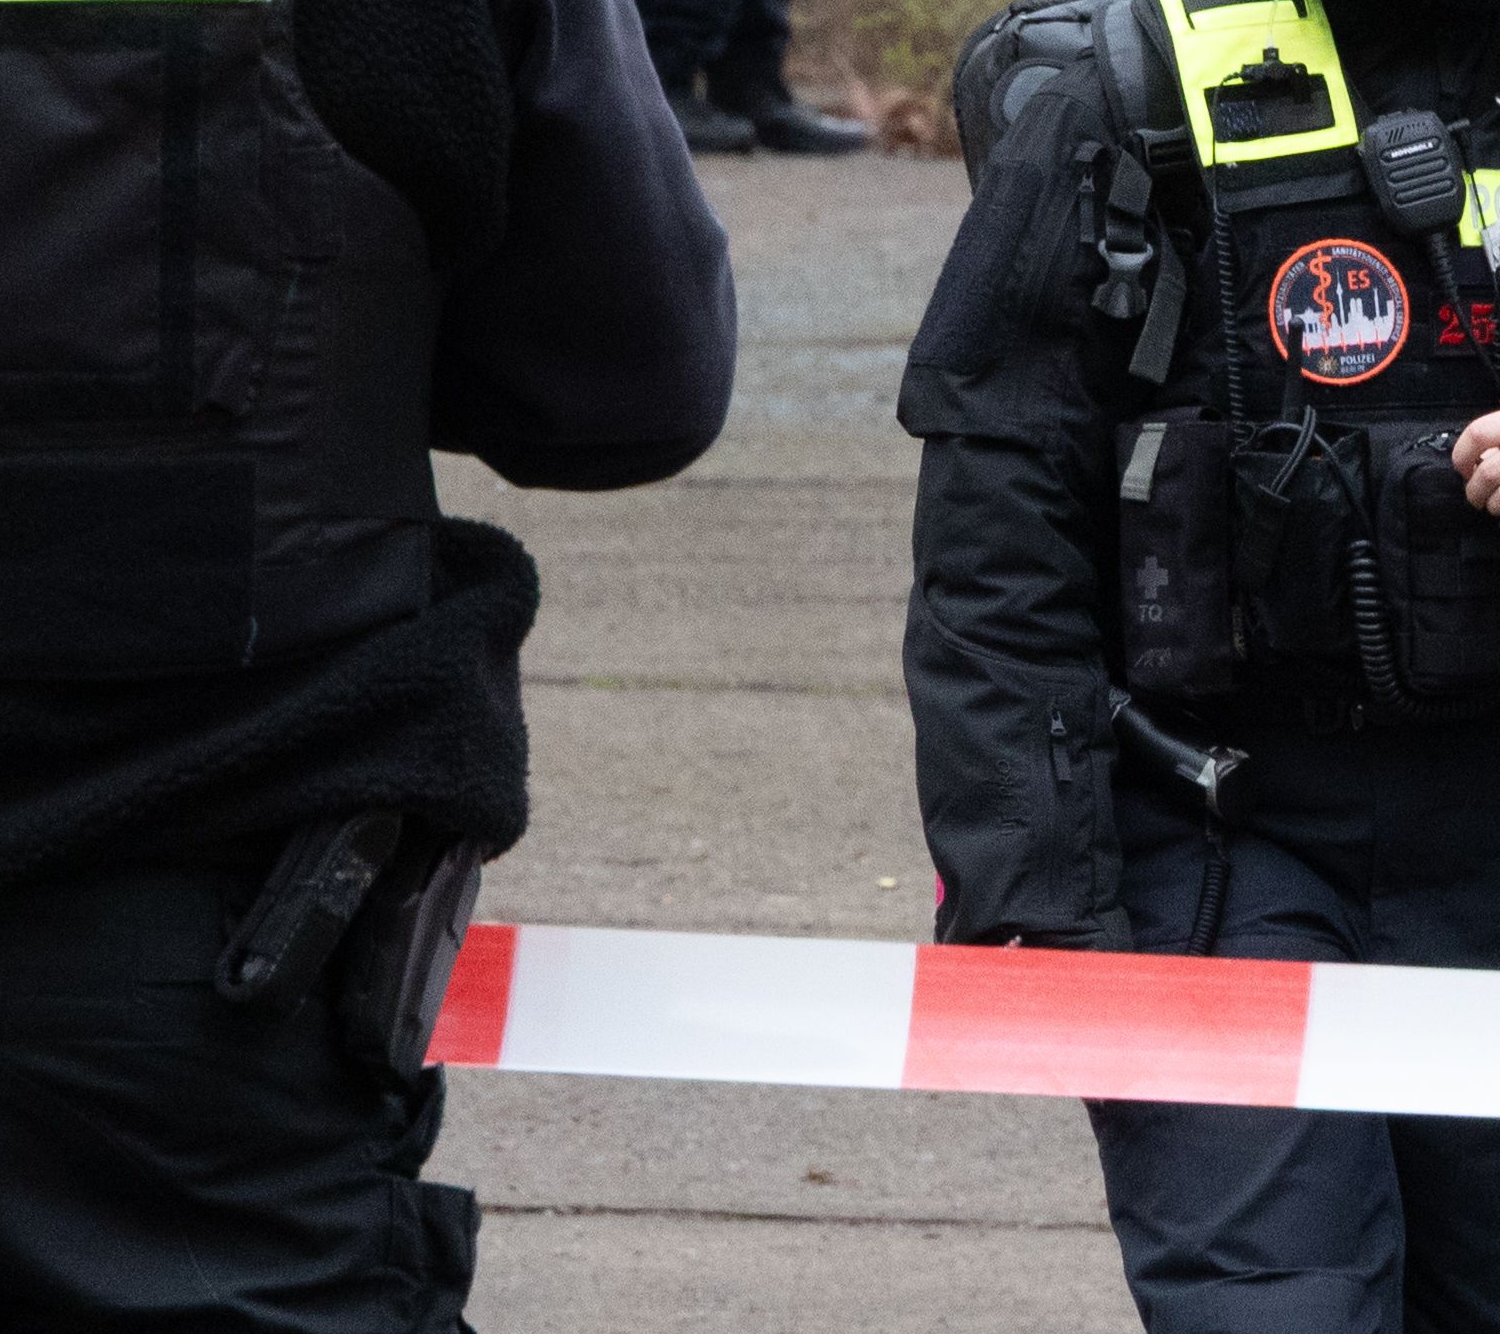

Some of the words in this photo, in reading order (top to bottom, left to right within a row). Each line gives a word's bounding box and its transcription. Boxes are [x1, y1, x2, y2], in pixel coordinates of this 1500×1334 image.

[1347, 269, 1371, 291] ES
[1437, 302, 1498, 346] 25
[1340, 353, 1376, 366] POLIZEI
[1137, 603, 1164, 624] TQ
